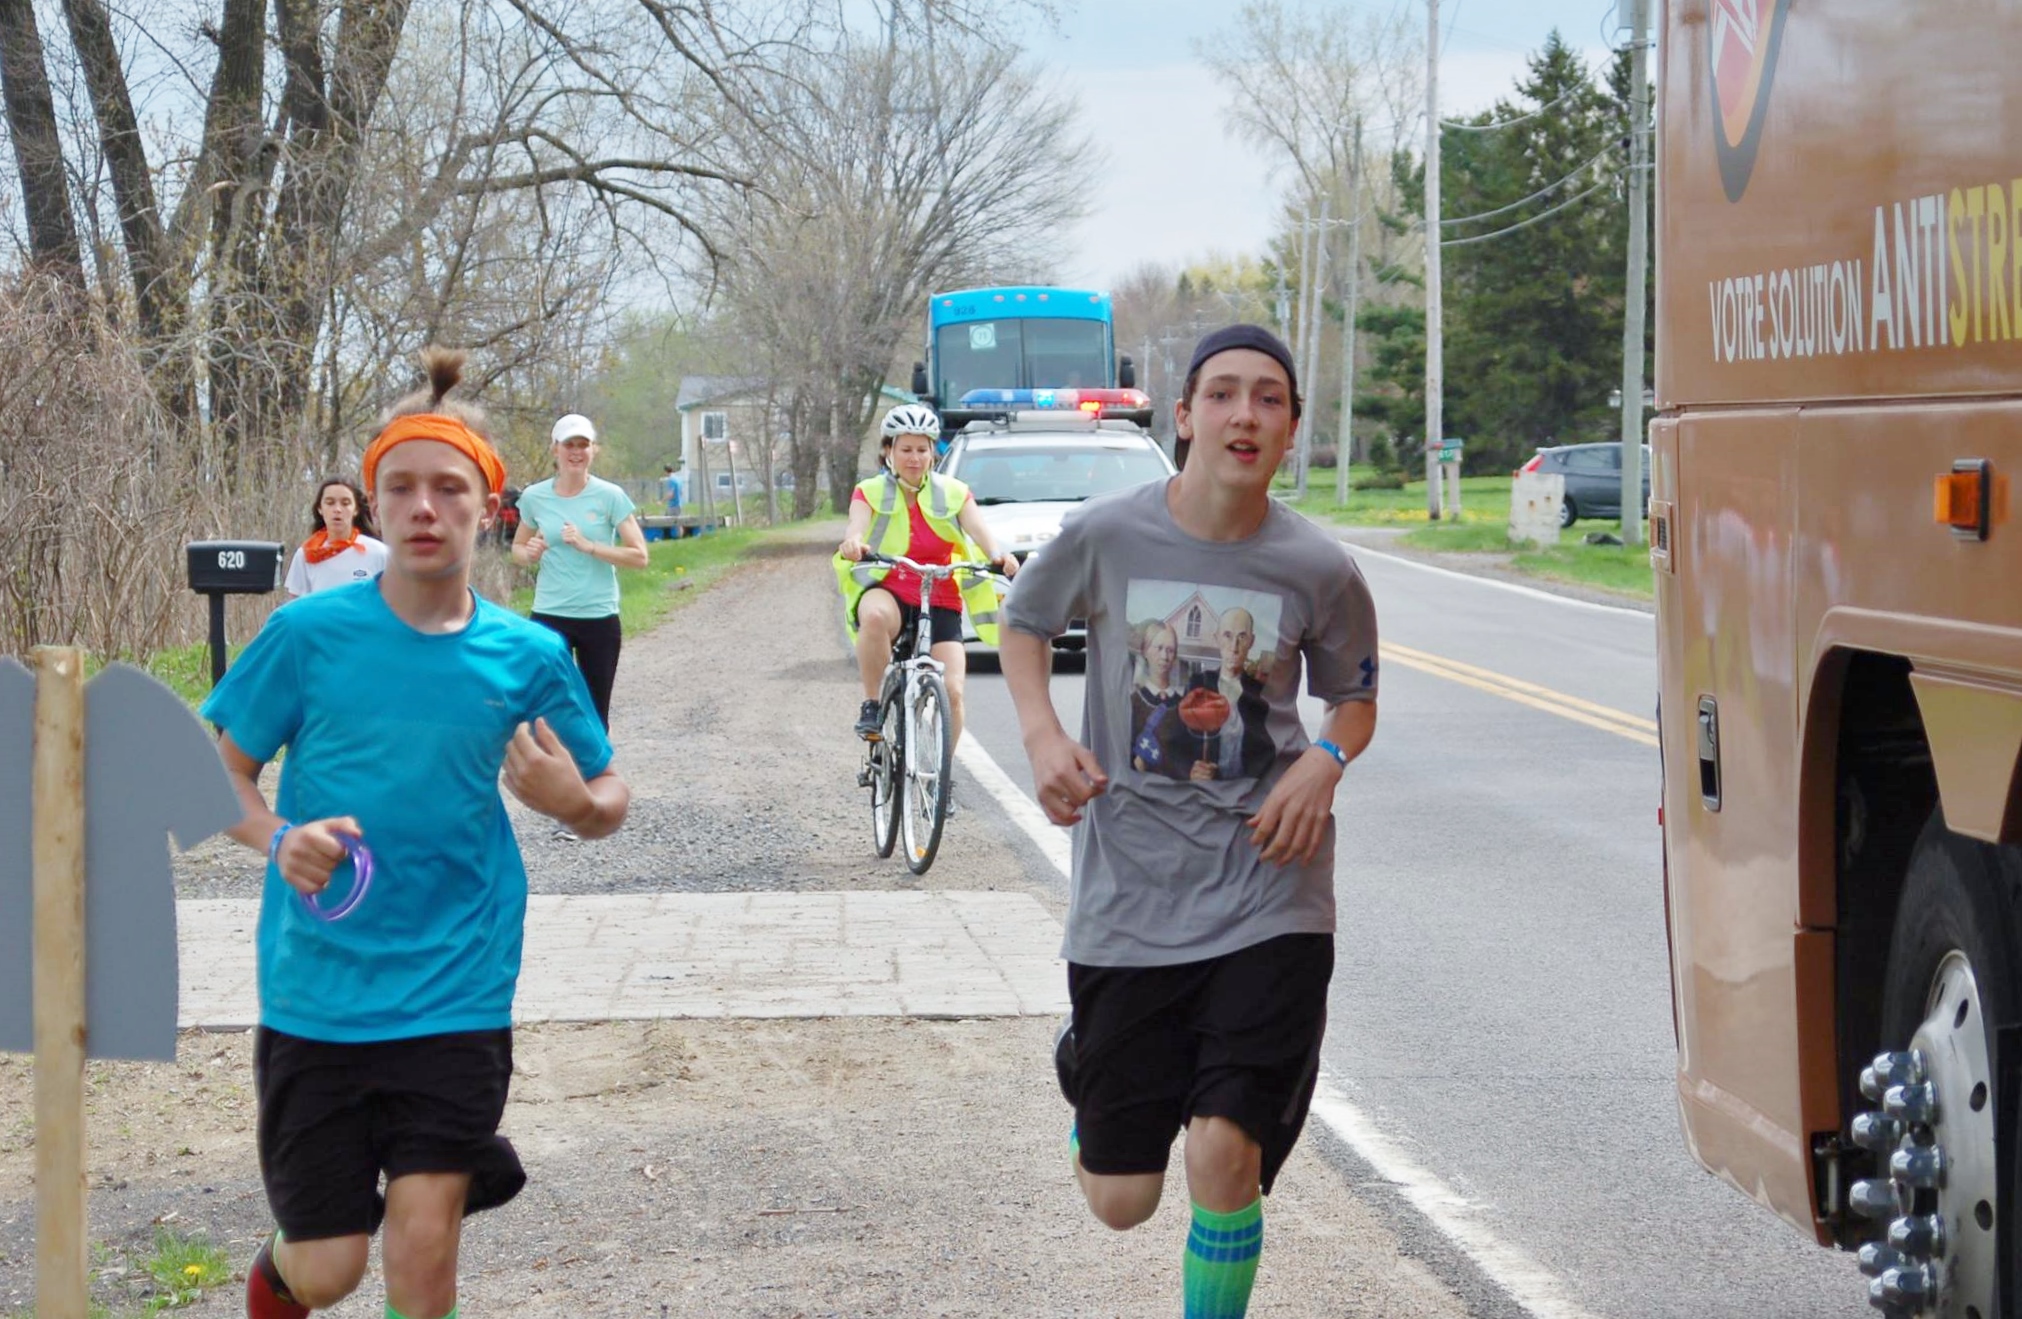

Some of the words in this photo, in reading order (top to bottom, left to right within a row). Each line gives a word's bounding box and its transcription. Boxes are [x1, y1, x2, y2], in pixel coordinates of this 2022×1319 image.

[1709, 274, 1764, 363] VOTRE
[1769, 259, 1863, 359] SOLUTION
[218, 551, 245, 569] 620
